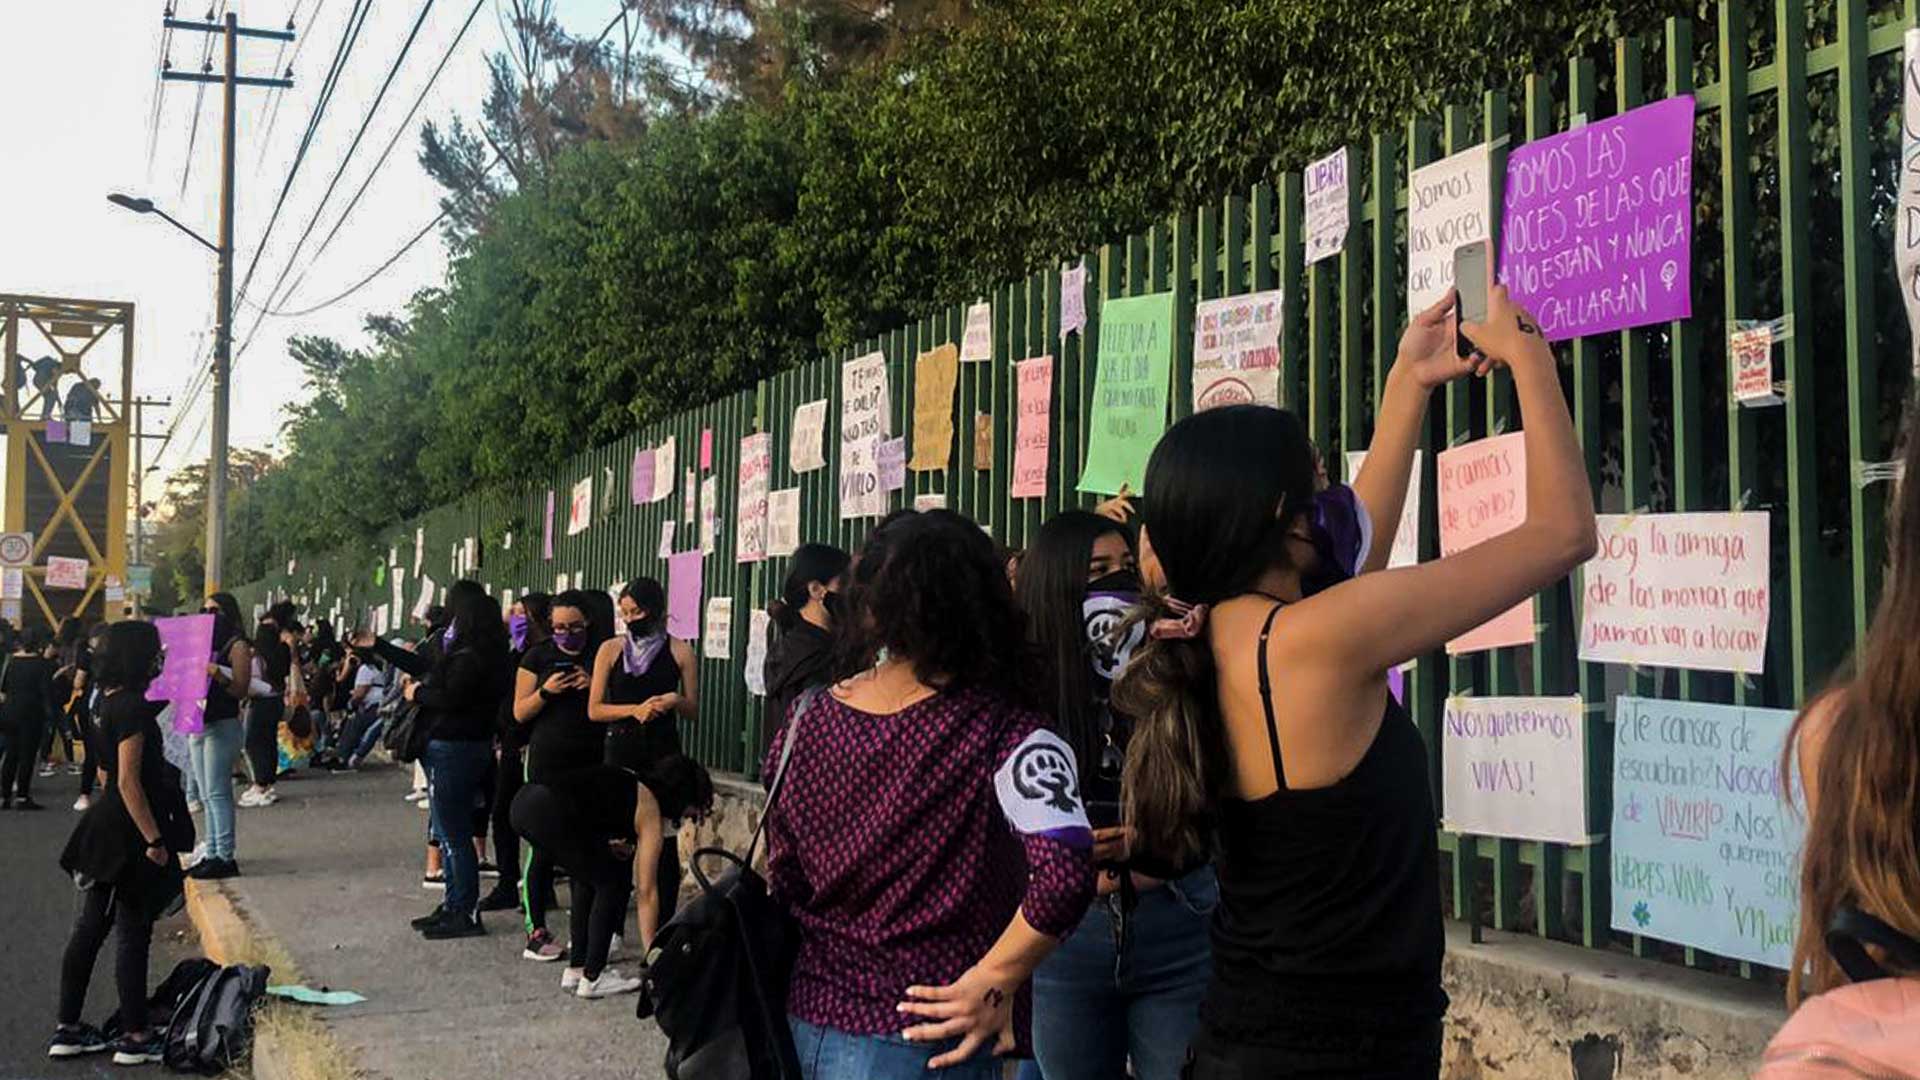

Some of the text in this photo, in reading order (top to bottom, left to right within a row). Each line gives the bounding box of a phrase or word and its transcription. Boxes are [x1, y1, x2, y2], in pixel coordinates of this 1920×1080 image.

[1505, 126, 1627, 208] SOMOS LAS
[1414, 170, 1472, 212] Somos
[1503, 156, 1690, 254] VOCES DE LAS QUE
[1411, 211, 1483, 253] las voces
[1514, 254, 1539, 295] NO
[1607, 232, 1619, 262] Y
[1625, 210, 1685, 260] NUNCA
[1411, 266, 1433, 292] de
[1650, 522, 1668, 556] la
[1675, 531, 1747, 576] amiga
[1589, 573, 1767, 617] de las morras que
[1661, 626, 1688, 648] vas
[1693, 629, 1704, 649] a
[1447, 709, 1573, 745] Nos queremos
[1660, 714, 1722, 750] cansas
[1732, 801, 1775, 842] Nos
